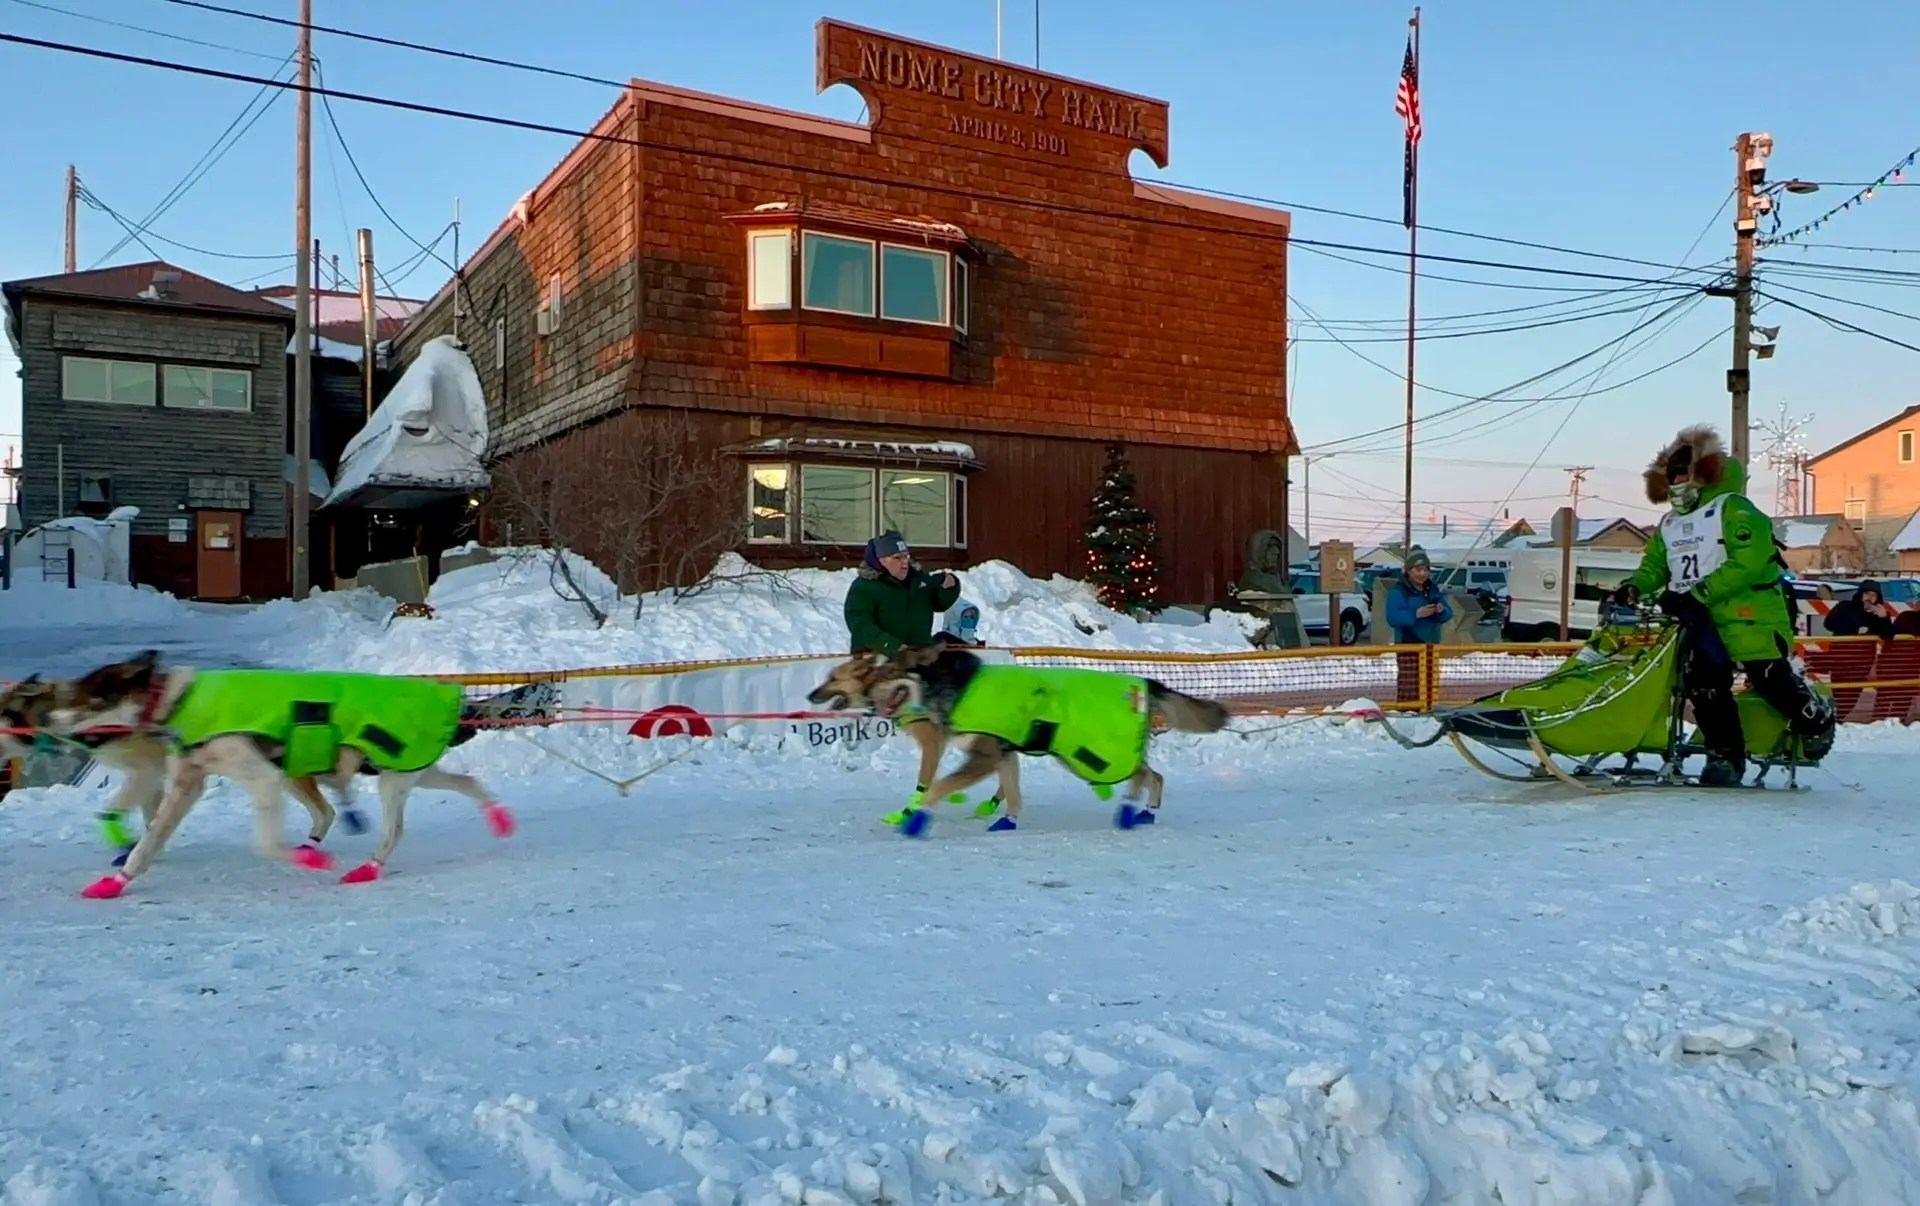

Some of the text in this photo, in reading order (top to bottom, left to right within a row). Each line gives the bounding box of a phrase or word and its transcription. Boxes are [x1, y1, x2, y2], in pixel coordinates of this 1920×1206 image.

[859, 40, 1148, 140] NOME CITY HALL
[949, 114, 1008, 140] APRIL
[1031, 131, 1069, 155] 1901
[1681, 554, 1699, 579] 21
[808, 718, 871, 747] Bank
